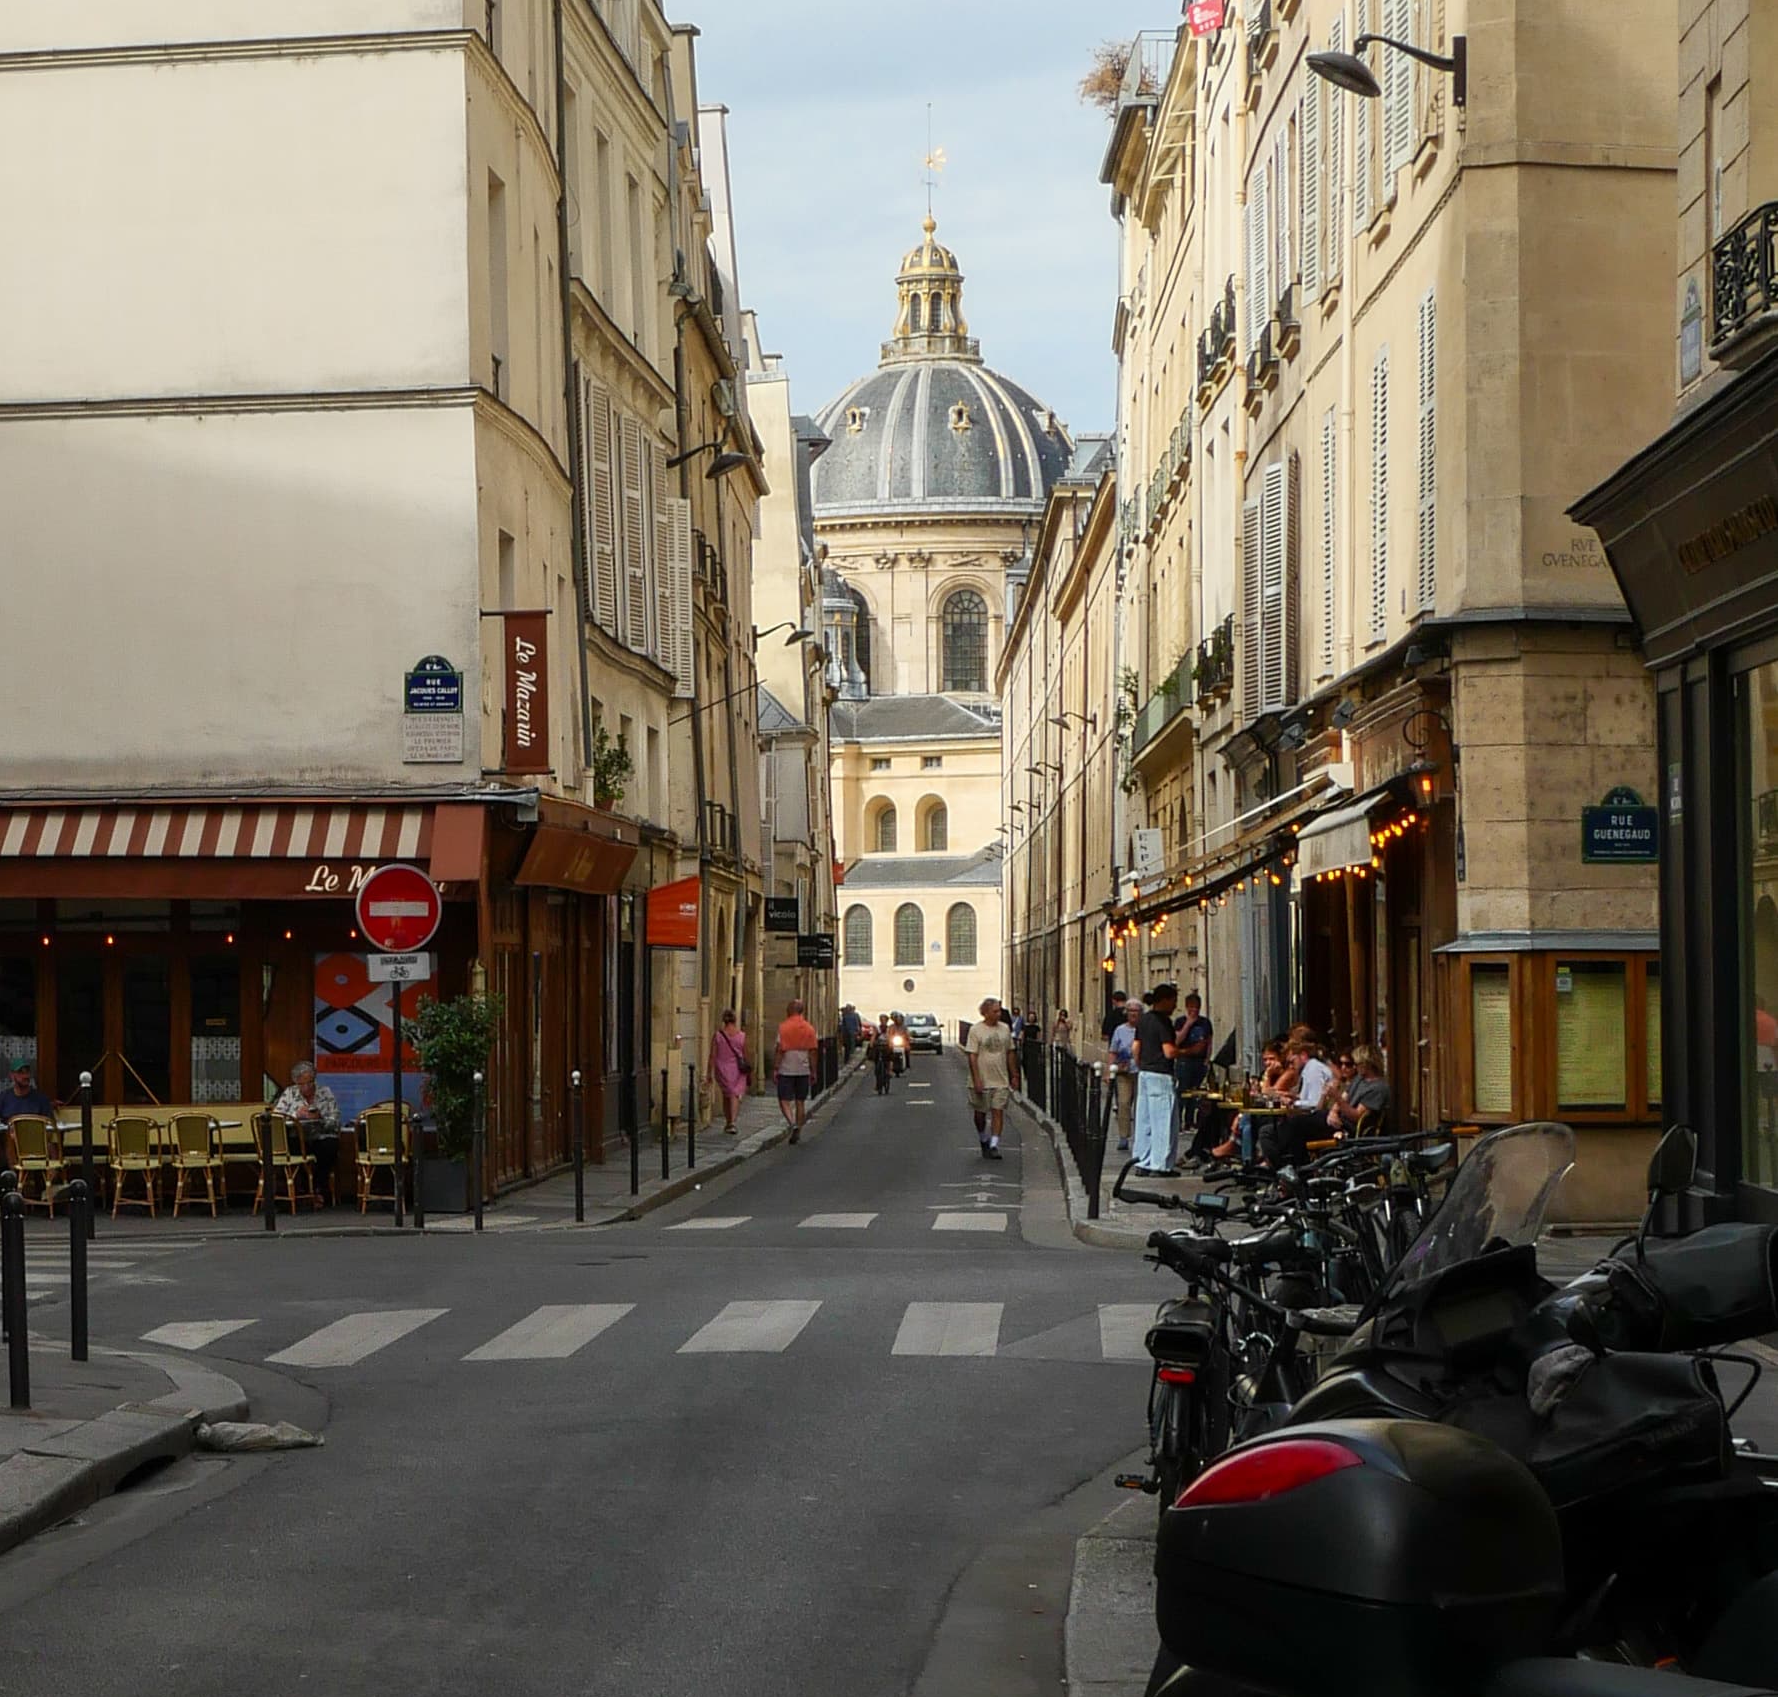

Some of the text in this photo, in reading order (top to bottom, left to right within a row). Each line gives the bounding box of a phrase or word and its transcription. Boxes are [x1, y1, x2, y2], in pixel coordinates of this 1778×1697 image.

[515, 636, 538, 748] Le Mazarin
[1610, 814, 1634, 827] RUE
[305, 864, 339, 892] Le
